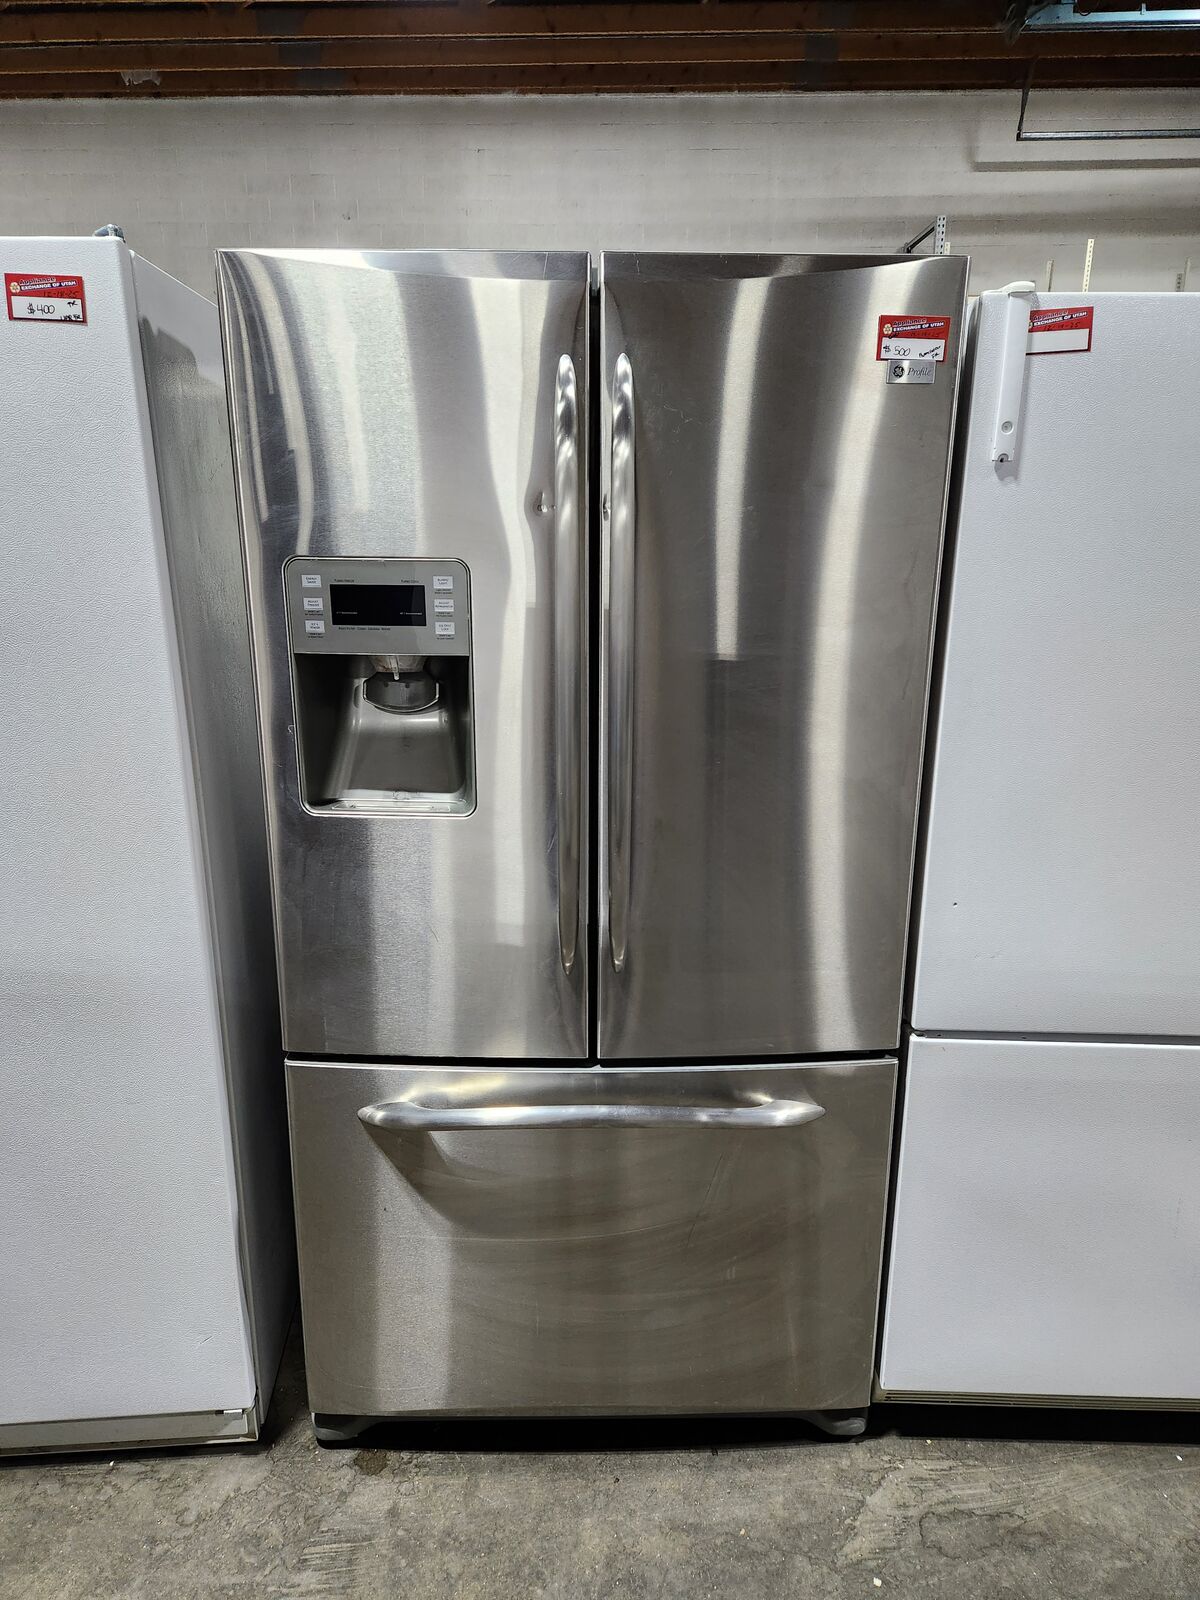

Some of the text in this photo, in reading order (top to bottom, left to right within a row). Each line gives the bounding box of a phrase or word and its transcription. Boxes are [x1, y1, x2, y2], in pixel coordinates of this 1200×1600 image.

[19, 277, 56, 286] Appliance
[20, 283, 51, 291] EXCHANGE
[893, 324, 921, 332] EXCHANGE
[907, 367, 931, 378] Profile
